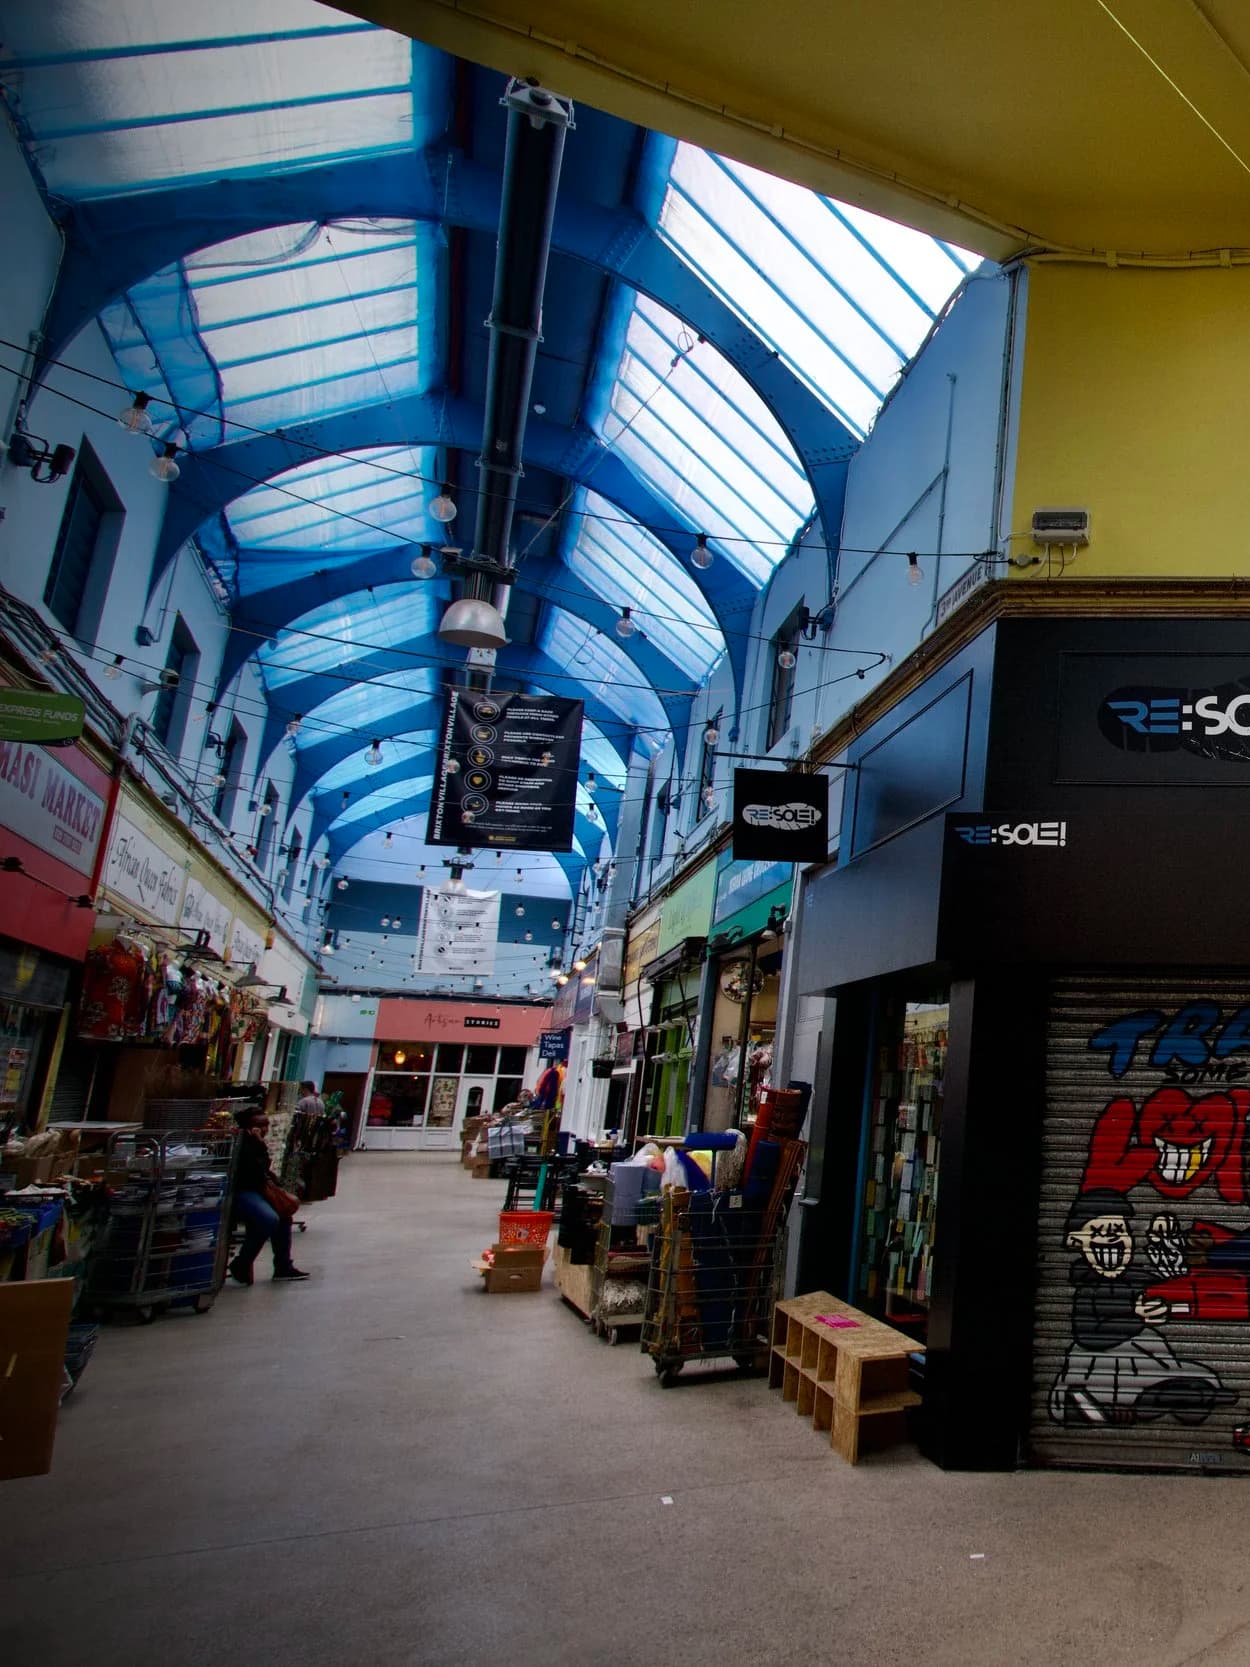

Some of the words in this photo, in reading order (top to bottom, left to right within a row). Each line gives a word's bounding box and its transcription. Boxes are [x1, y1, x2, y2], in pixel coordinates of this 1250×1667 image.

[952, 566, 983, 606] AVENUE
[43, 709, 79, 722] FUNDS
[41, 768, 100, 842] MARKET
[543, 1041, 564, 1050] Tapas
[1162, 1061, 1248, 1085] SOME
